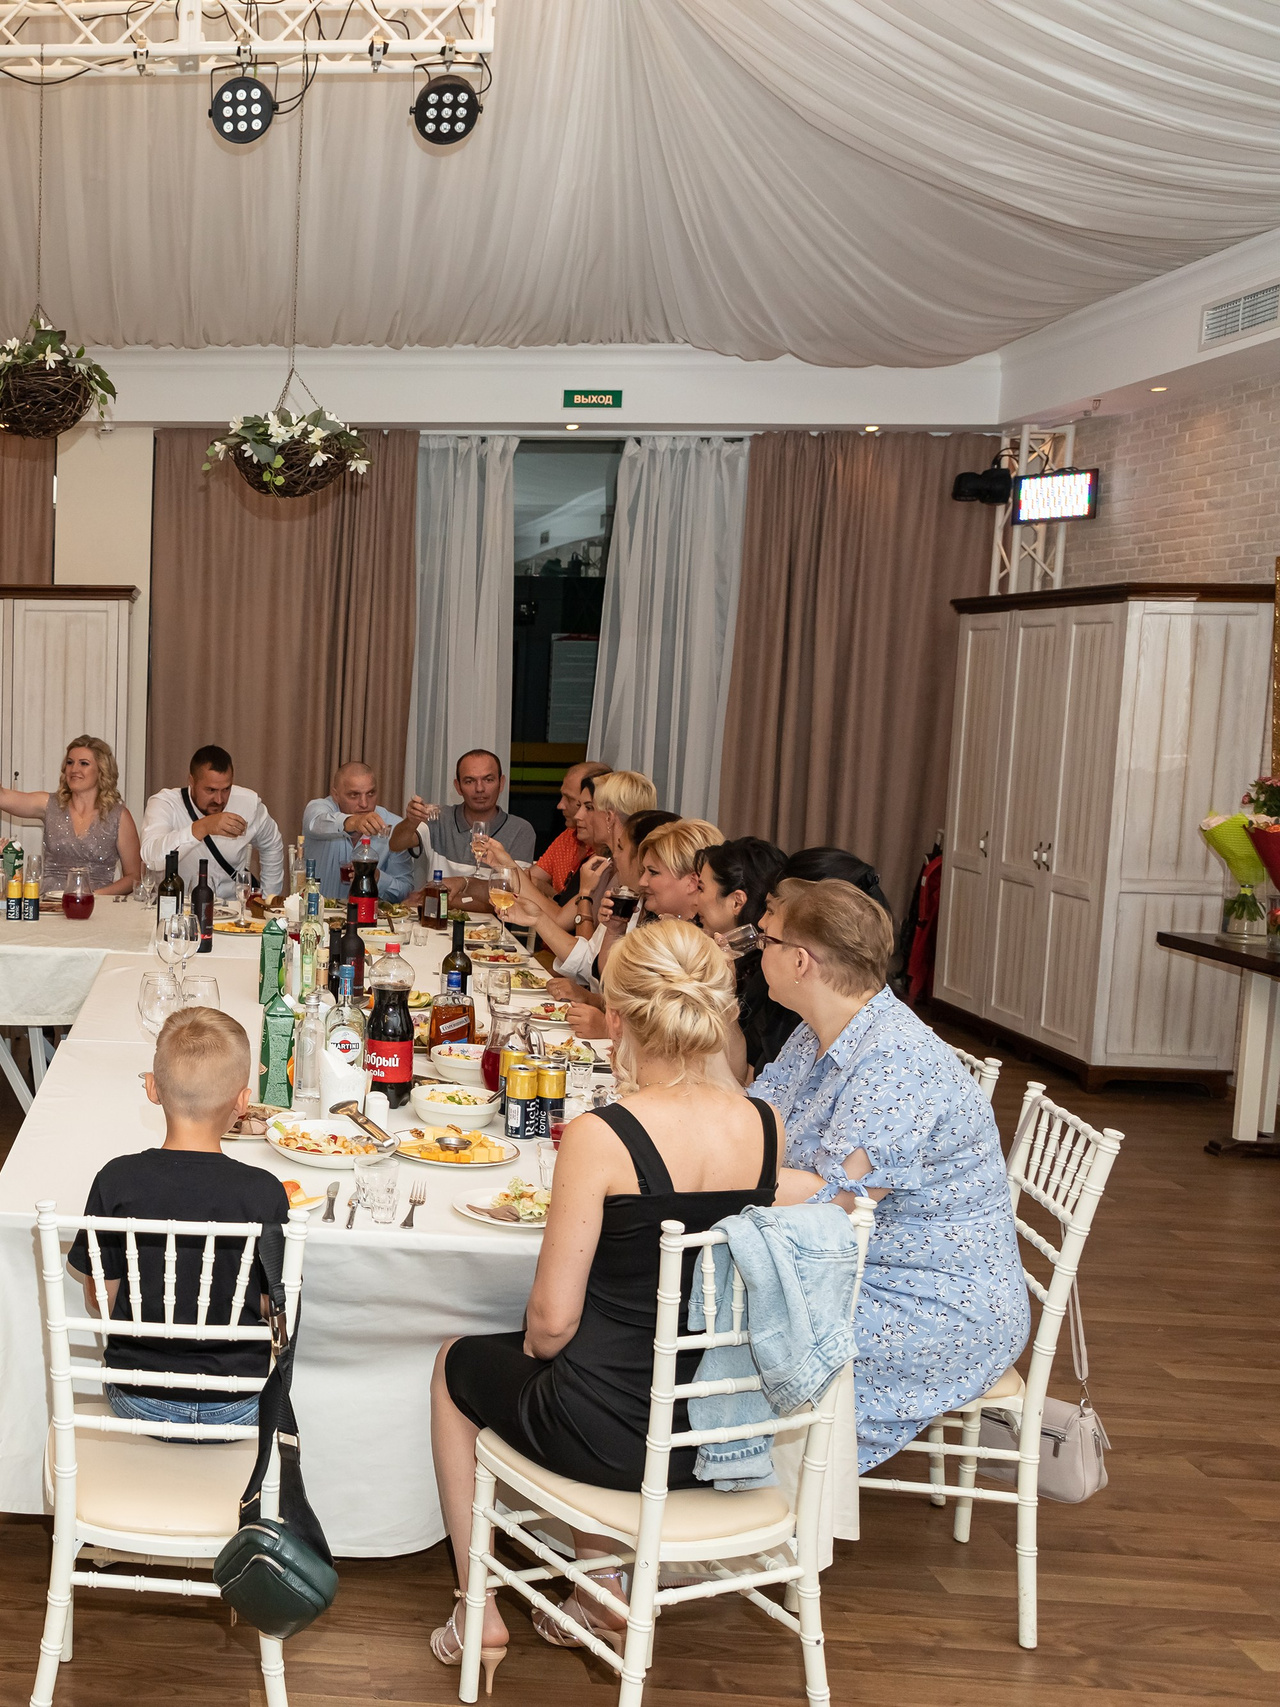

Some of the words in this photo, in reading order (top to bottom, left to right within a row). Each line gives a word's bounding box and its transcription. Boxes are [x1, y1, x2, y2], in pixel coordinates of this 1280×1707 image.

[573, 394, 613, 405] ВЫХОД
[8, 899, 16, 919] Rich
[525, 1102, 536, 1136] Rich
[539, 1110, 547, 1134] tonic
